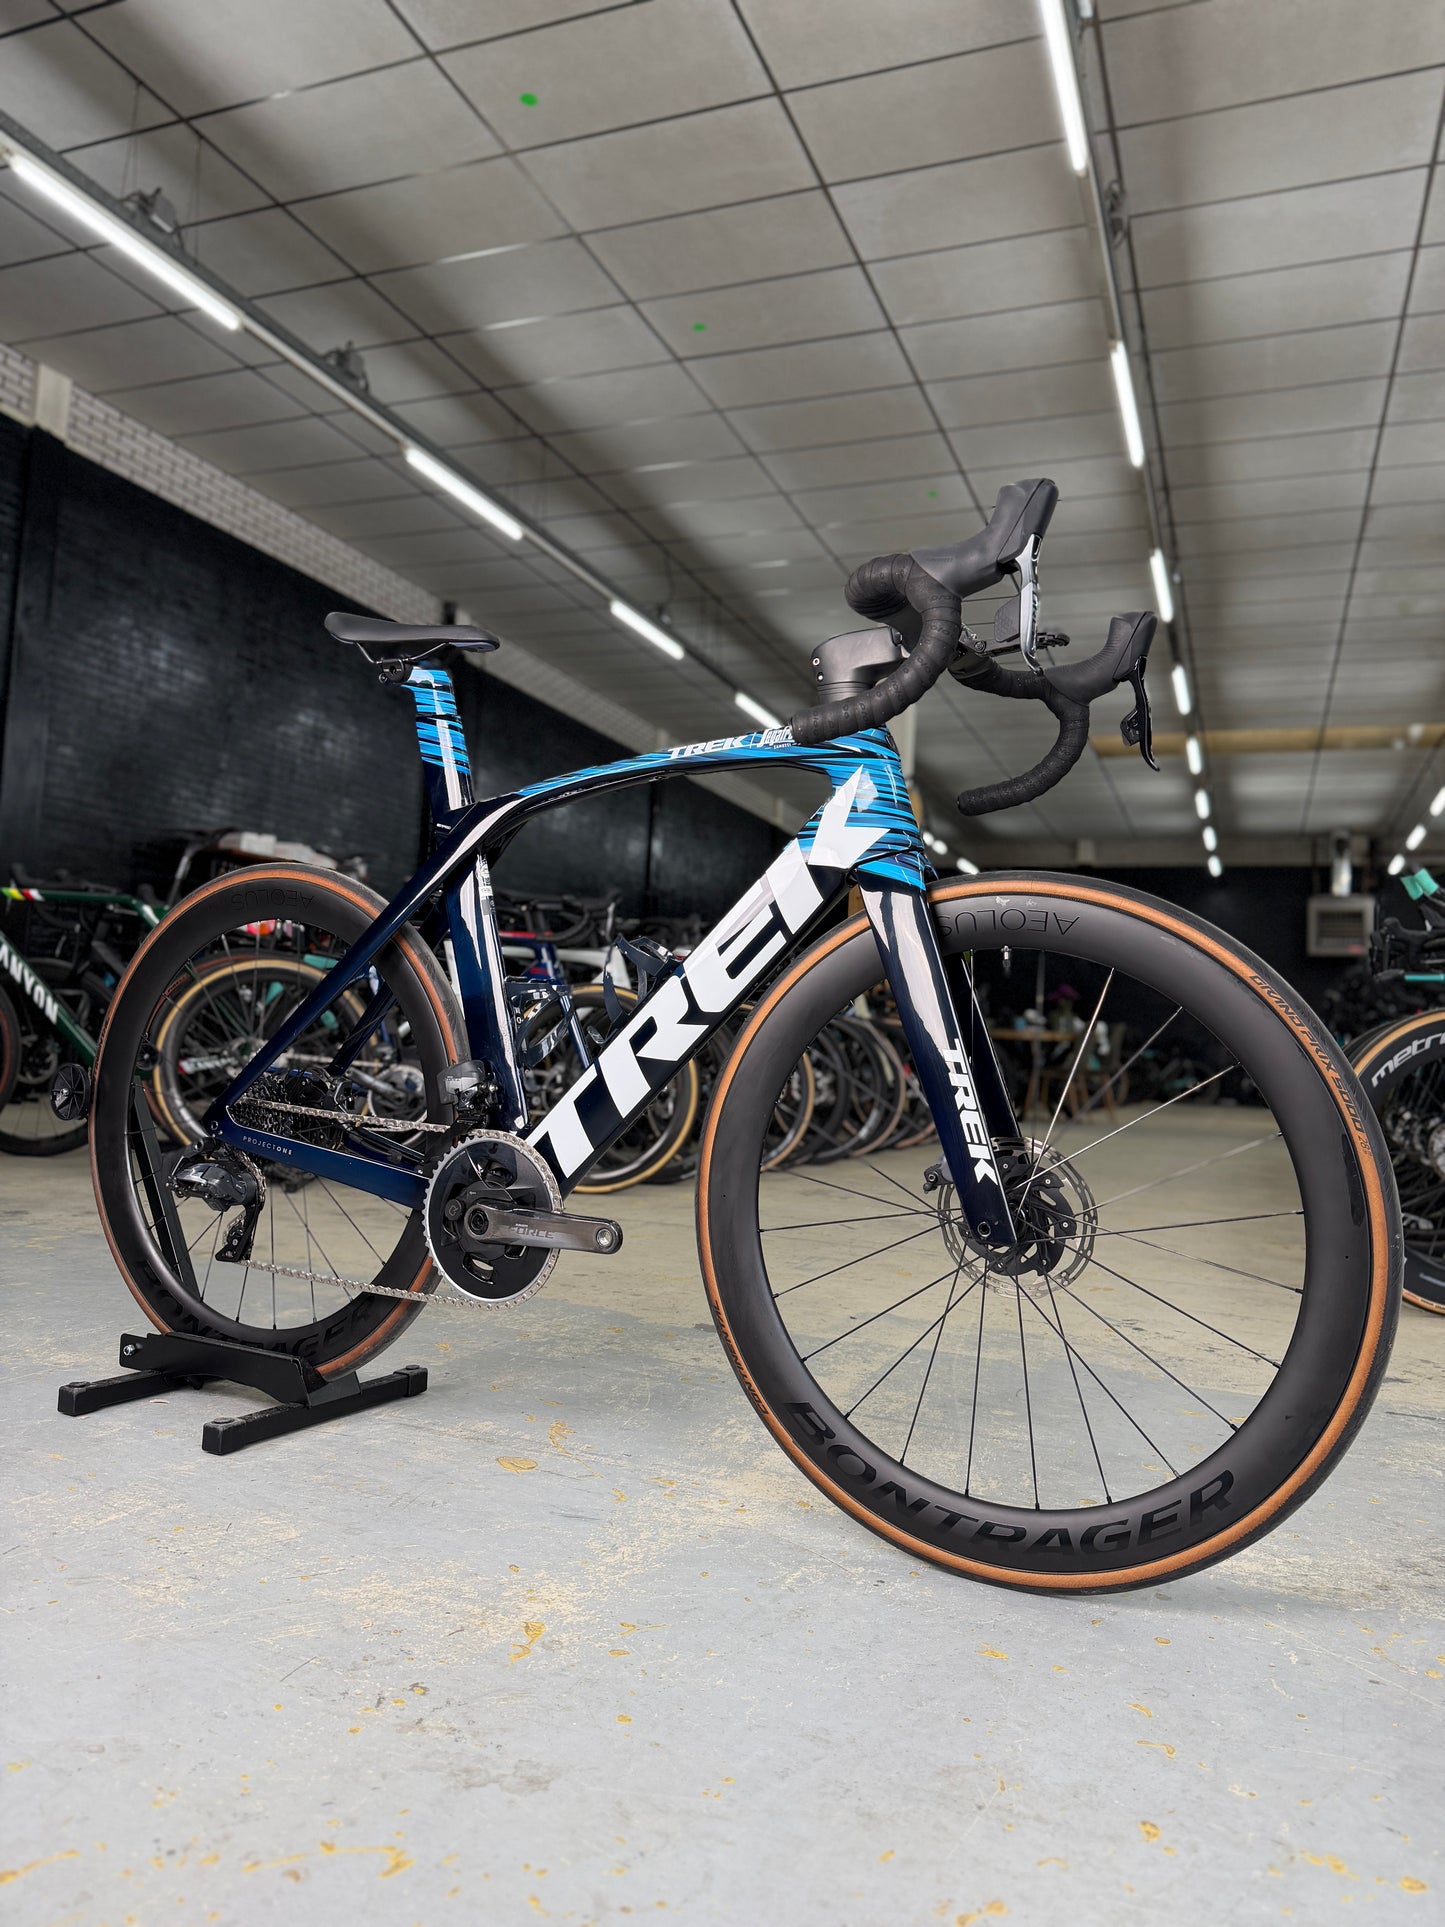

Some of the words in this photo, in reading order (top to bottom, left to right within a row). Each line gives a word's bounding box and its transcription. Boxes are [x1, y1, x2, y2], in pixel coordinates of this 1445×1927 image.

[668, 735, 748, 759] TREK
[231, 888, 315, 911] AEOLUS
[936, 908, 1080, 937] AEOLUS
[0, 943, 59, 1025] ANYON
[524, 765, 890, 1179] TREK
[1249, 974, 1306, 1029] GRAND
[1300, 1027, 1338, 1073] PRIX
[1331, 1072, 1366, 1134] 5000
[943, 1038, 999, 1186] TREK
[713, 1300, 769, 1415] CONTINENTAL
[784, 1401, 1235, 1556] BONTRAGER
